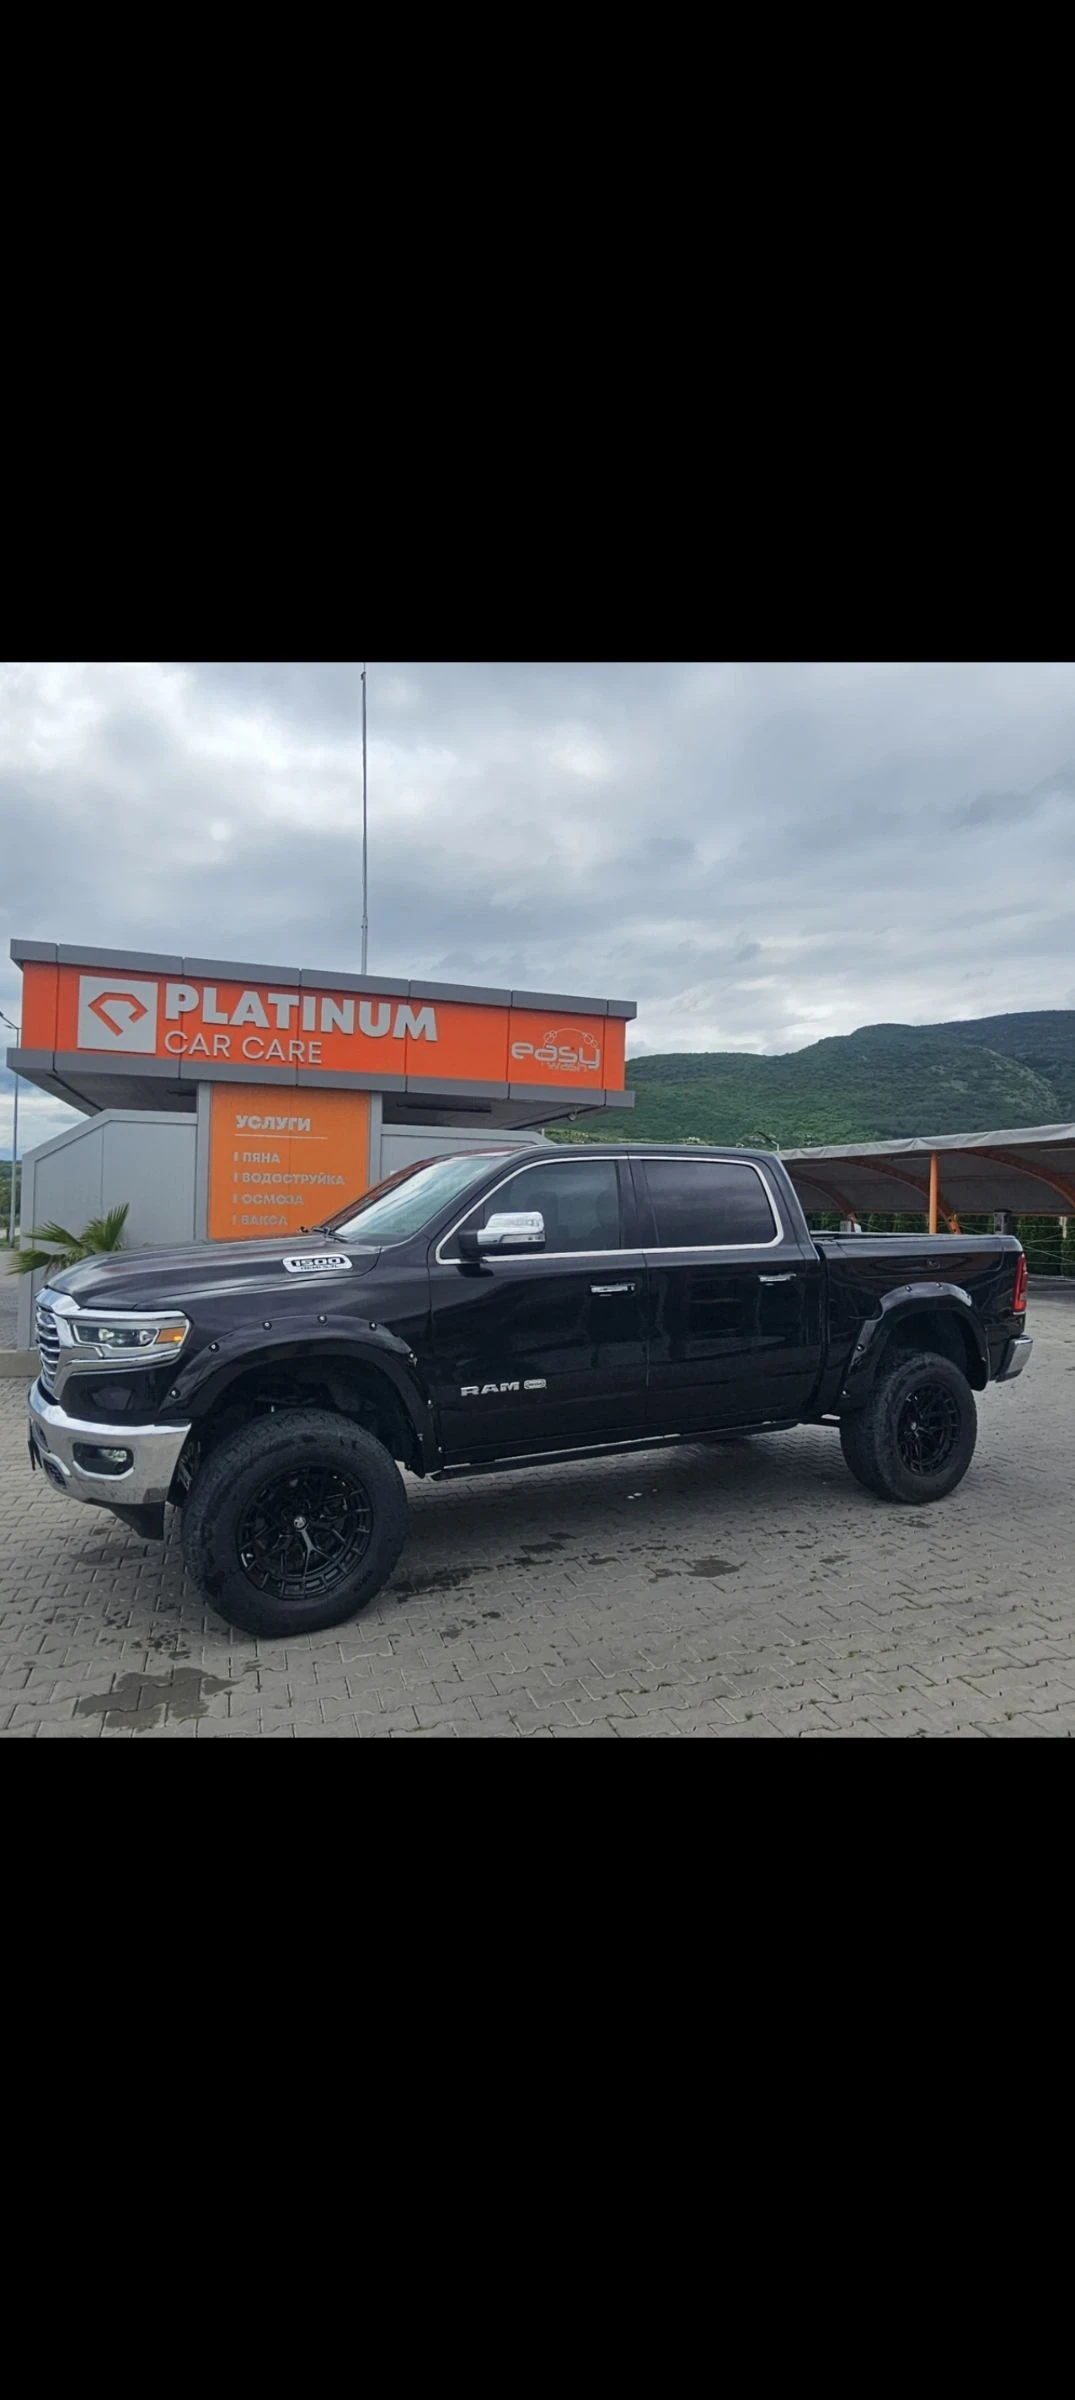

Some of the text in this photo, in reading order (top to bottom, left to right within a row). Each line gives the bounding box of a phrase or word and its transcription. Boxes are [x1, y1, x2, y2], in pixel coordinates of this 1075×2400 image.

[165, 983, 438, 1042] PLATINUM
[164, 1030, 322, 1064] CAR CARE
[511, 1042, 600, 1070] easy
[235, 1114, 311, 1131] УСЛУГИ
[243, 1152, 280, 1163] ПЯНА
[242, 1172, 345, 1185] ВОДОСТРУЙКА
[242, 1193, 304, 1205] ОСМОЗА
[294, 1257, 342, 1267] 1500
[460, 1381, 520, 1397] RAM
